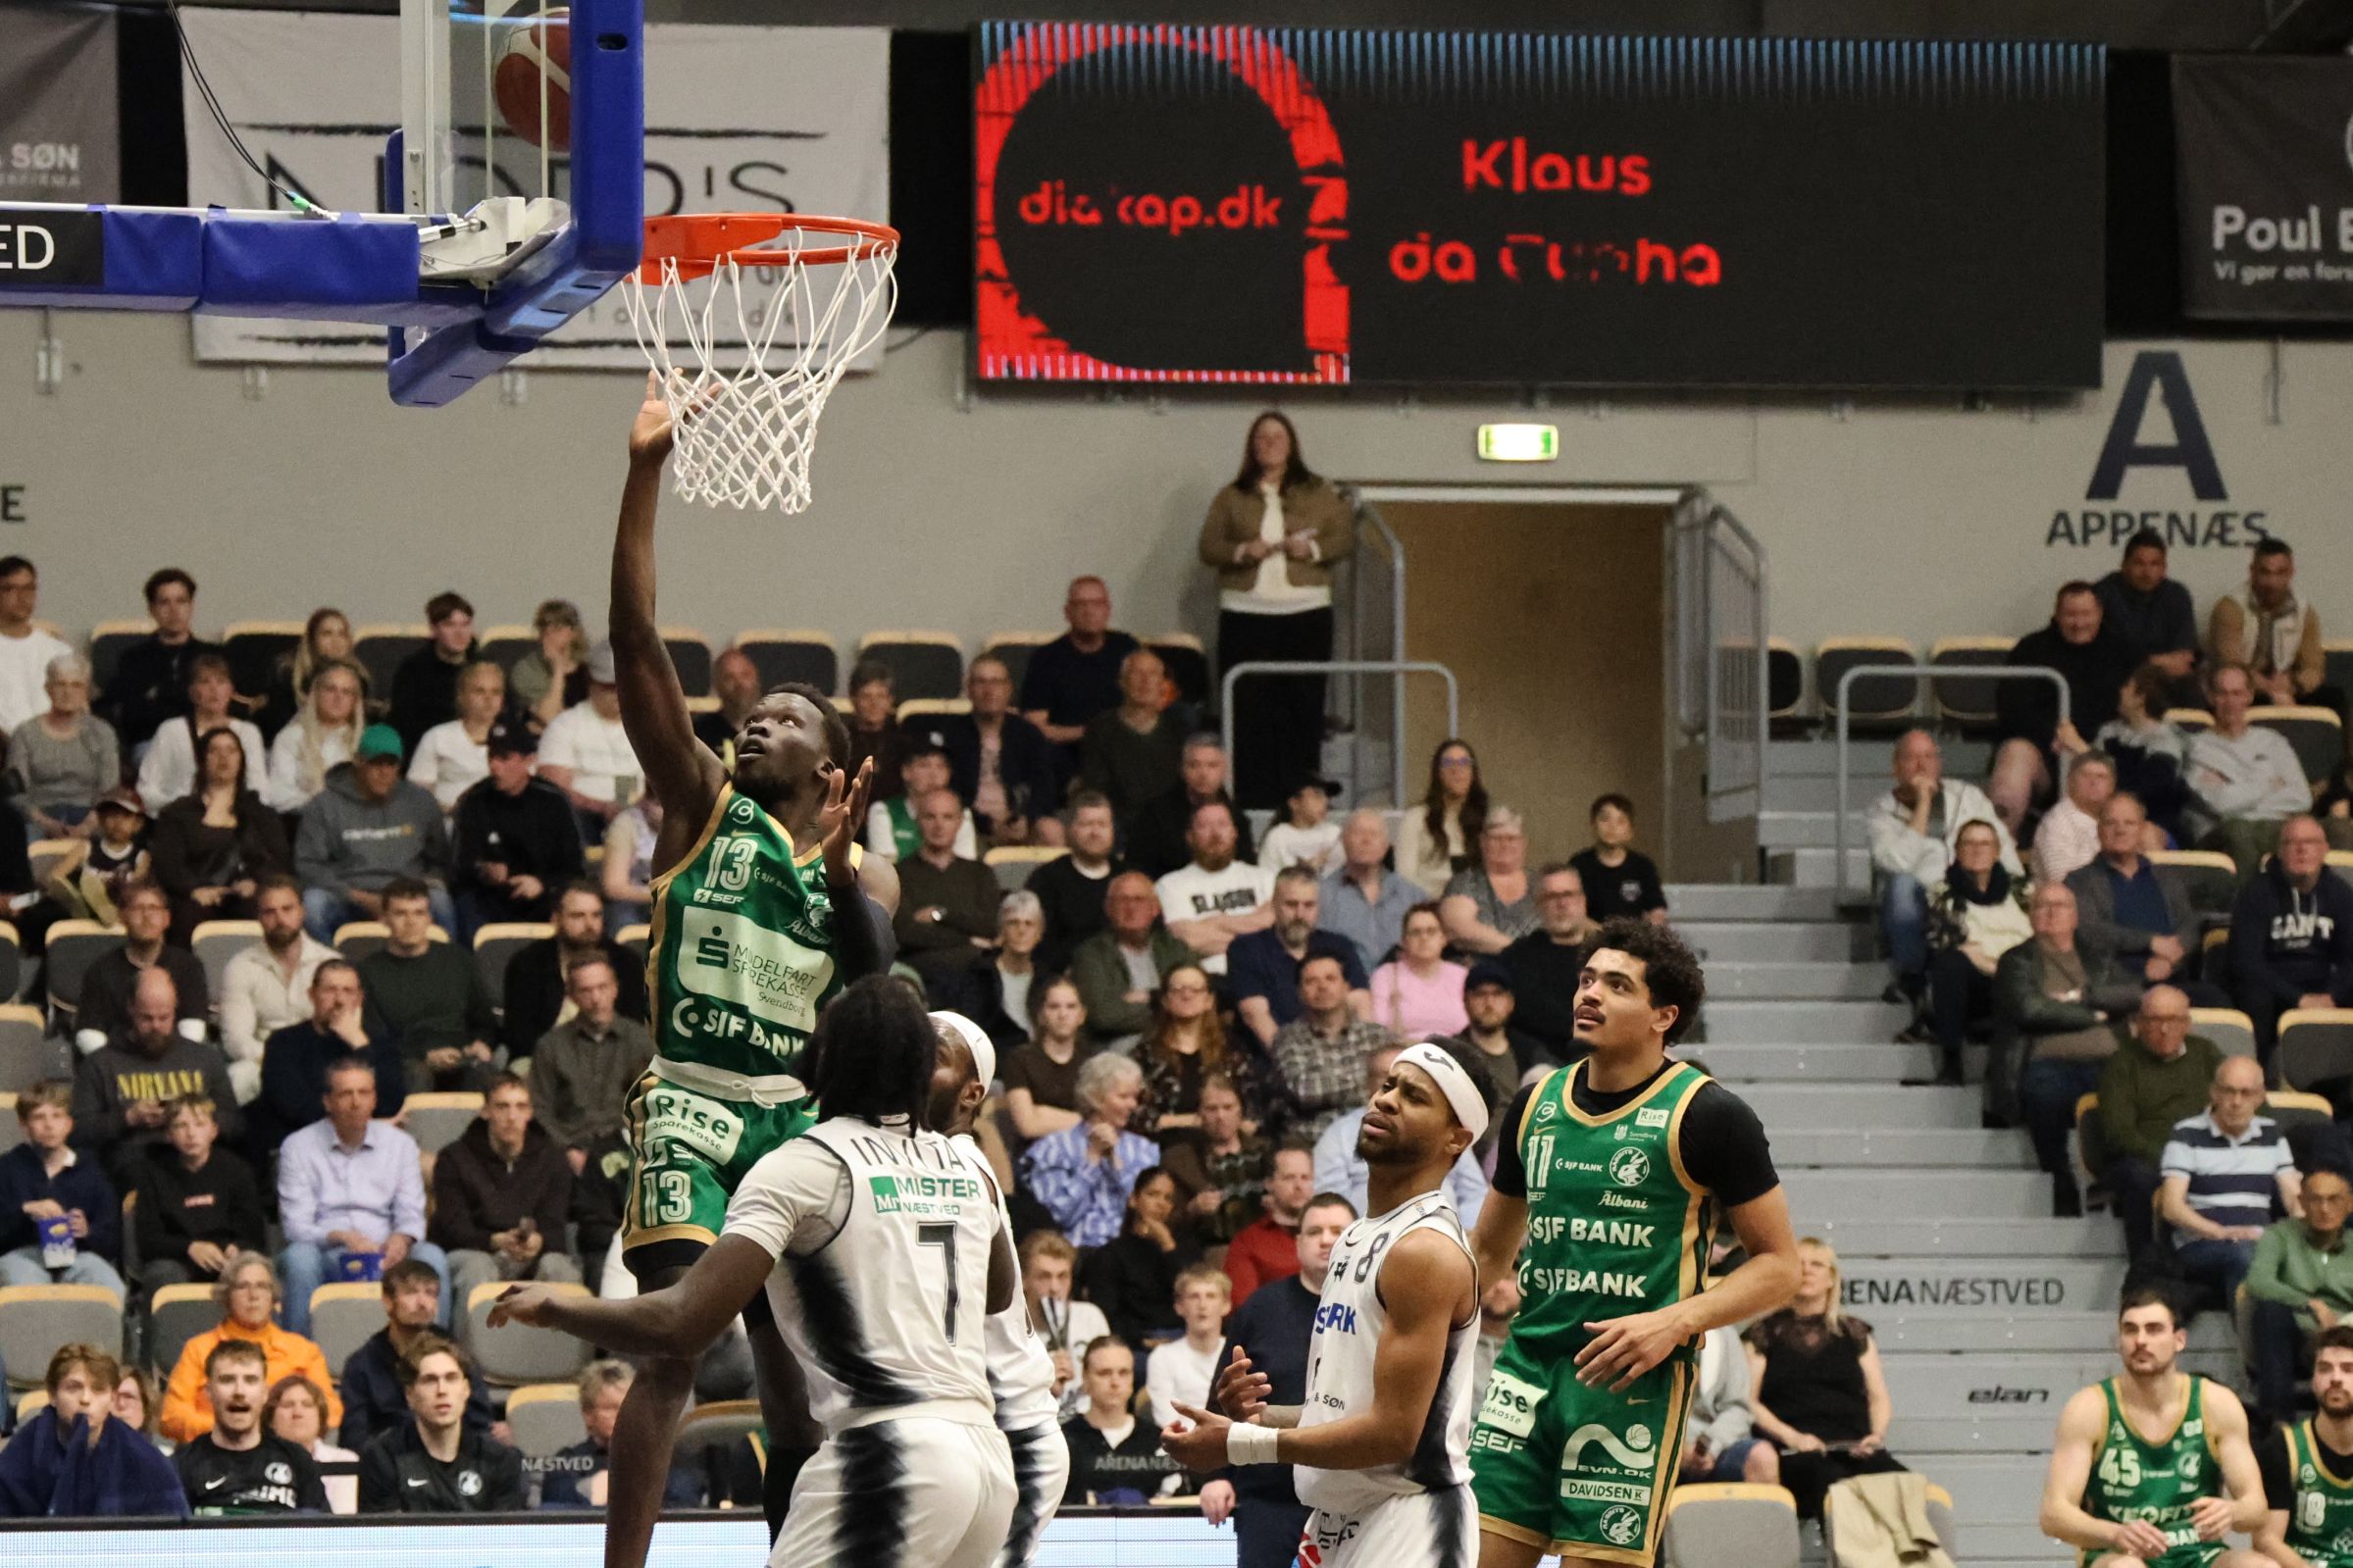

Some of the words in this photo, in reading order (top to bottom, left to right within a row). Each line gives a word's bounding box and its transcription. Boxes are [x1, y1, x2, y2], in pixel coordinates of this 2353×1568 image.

[1462, 136, 1652, 195] Klaus
[2213, 204, 2322, 251] Poul
[1389, 231, 1476, 282] da
[2086, 351, 2227, 500] A
[1, 484, 26, 522] E
[704, 835, 758, 891] 13
[703, 1008, 746, 1037] SJF
[655, 1094, 730, 1139] Rise
[1641, 1110, 1664, 1121] Rise
[653, 1119, 722, 1151] Sparekasse
[1527, 1136, 1556, 1188] 11
[1579, 1163, 1604, 1173] BANK
[642, 1170, 691, 1227] 13
[896, 1177, 981, 1198] MISTER
[903, 1202, 961, 1215] NÆSTVED
[1533, 1216, 1565, 1244] SJF
[1570, 1218, 1655, 1247] BANK
[1354, 1232, 1390, 1284] 8
[916, 1221, 960, 1346] 7
[1534, 1268, 1564, 1295] SJF
[1565, 1269, 1648, 1298] BANK
[1322, 1392, 1346, 1411] SØN
[1968, 1385, 2050, 1404] elan
[1472, 1429, 1527, 1454] SEF
[521, 1456, 594, 1472] NÆSTVED
[2098, 1447, 2141, 1488] 45
[1569, 1482, 1632, 1500] DAVIDSEN
